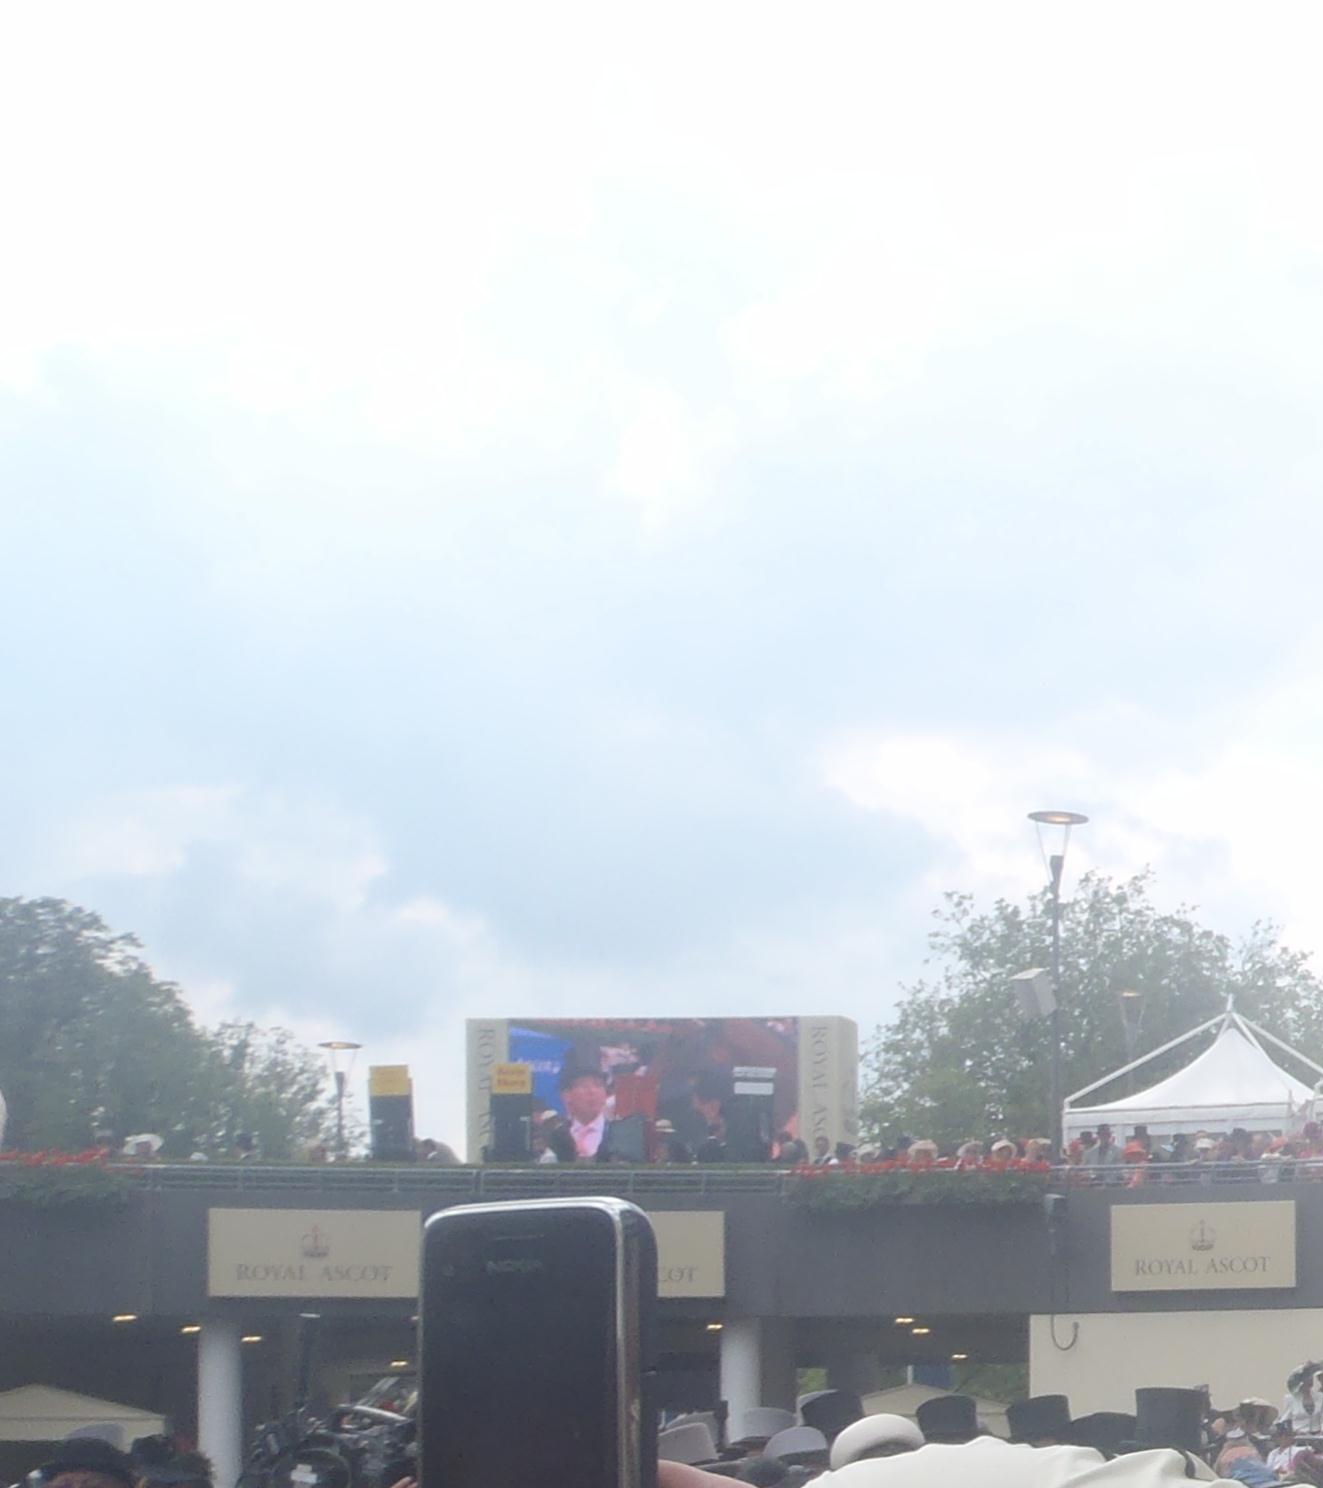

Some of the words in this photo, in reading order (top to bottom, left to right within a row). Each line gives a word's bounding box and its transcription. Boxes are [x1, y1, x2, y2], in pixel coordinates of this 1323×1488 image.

[813, 1025, 829, 1088] ROYAL
[236, 1263, 305, 1281] ROYAL
[321, 1264, 393, 1282] ASCOT
[1135, 1258, 1199, 1276] ROYAL
[1206, 1256, 1271, 1274] ASCOT
